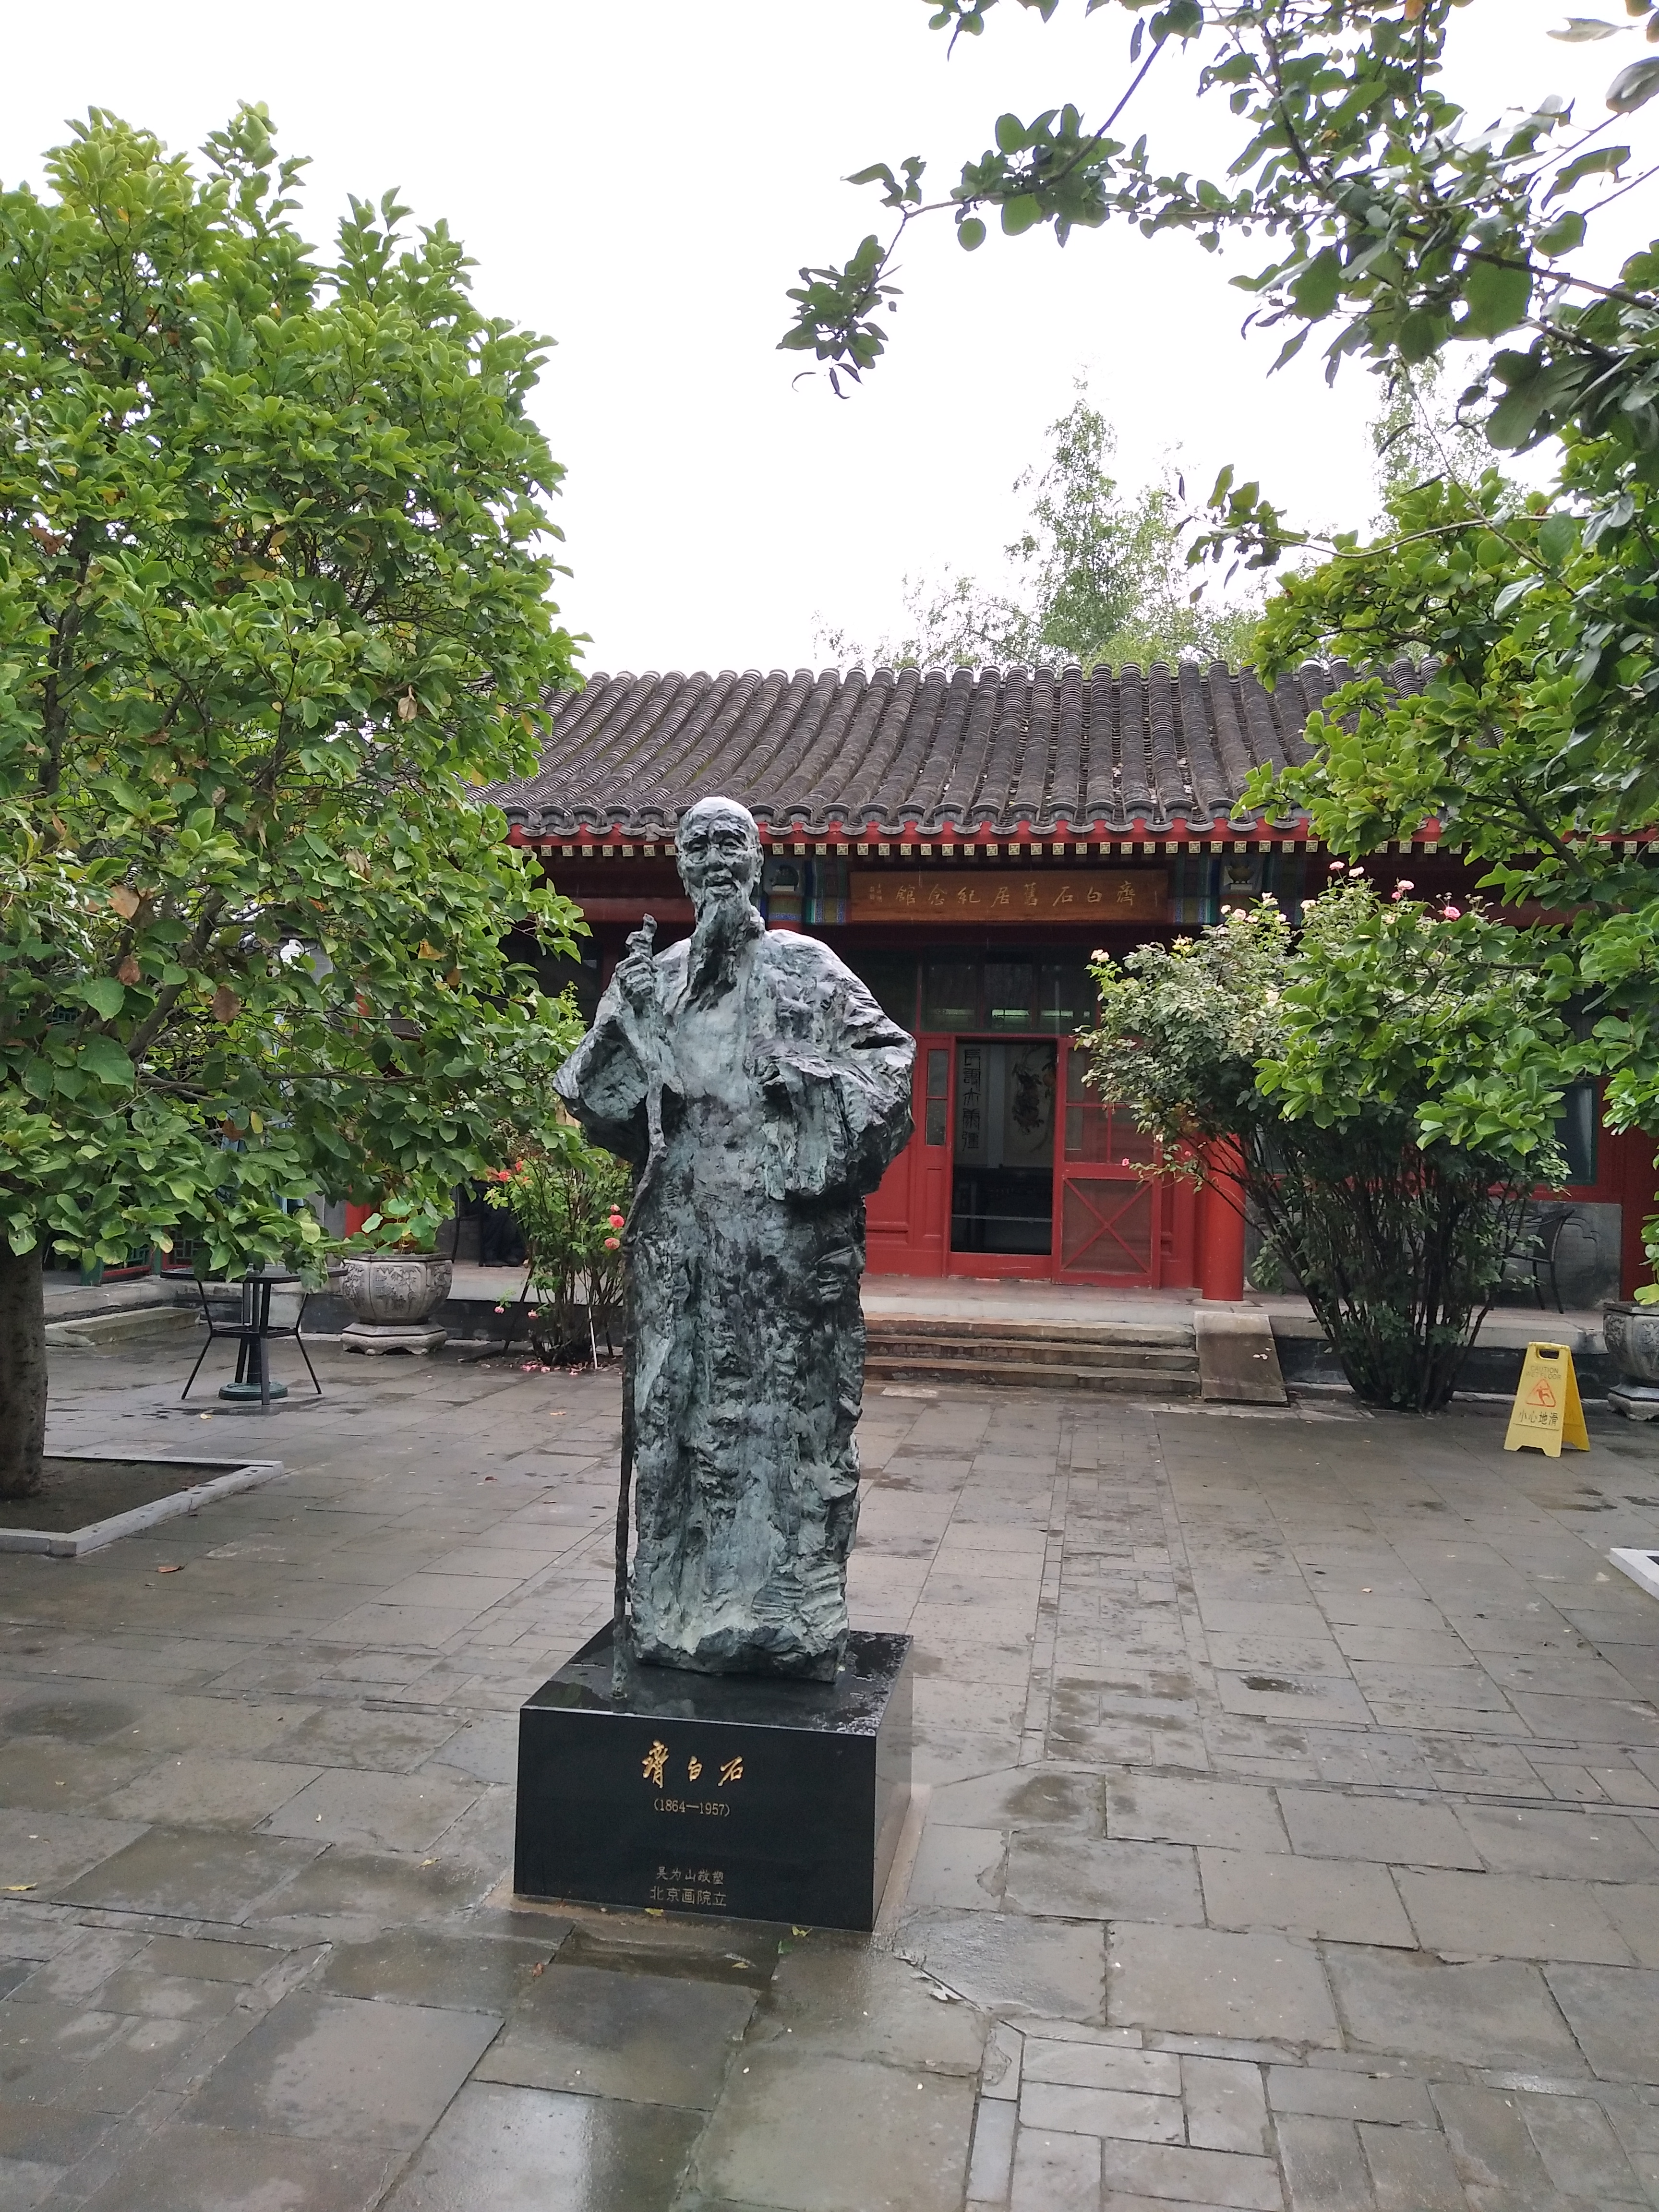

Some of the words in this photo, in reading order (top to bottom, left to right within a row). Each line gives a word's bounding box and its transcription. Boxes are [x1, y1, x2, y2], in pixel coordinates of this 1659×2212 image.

[1530, 1365, 1559, 1374] CAUTION
[1519, 1409, 1558, 1426] 小心地滑
[650, 1886, 727, 1907] 北京画院立
